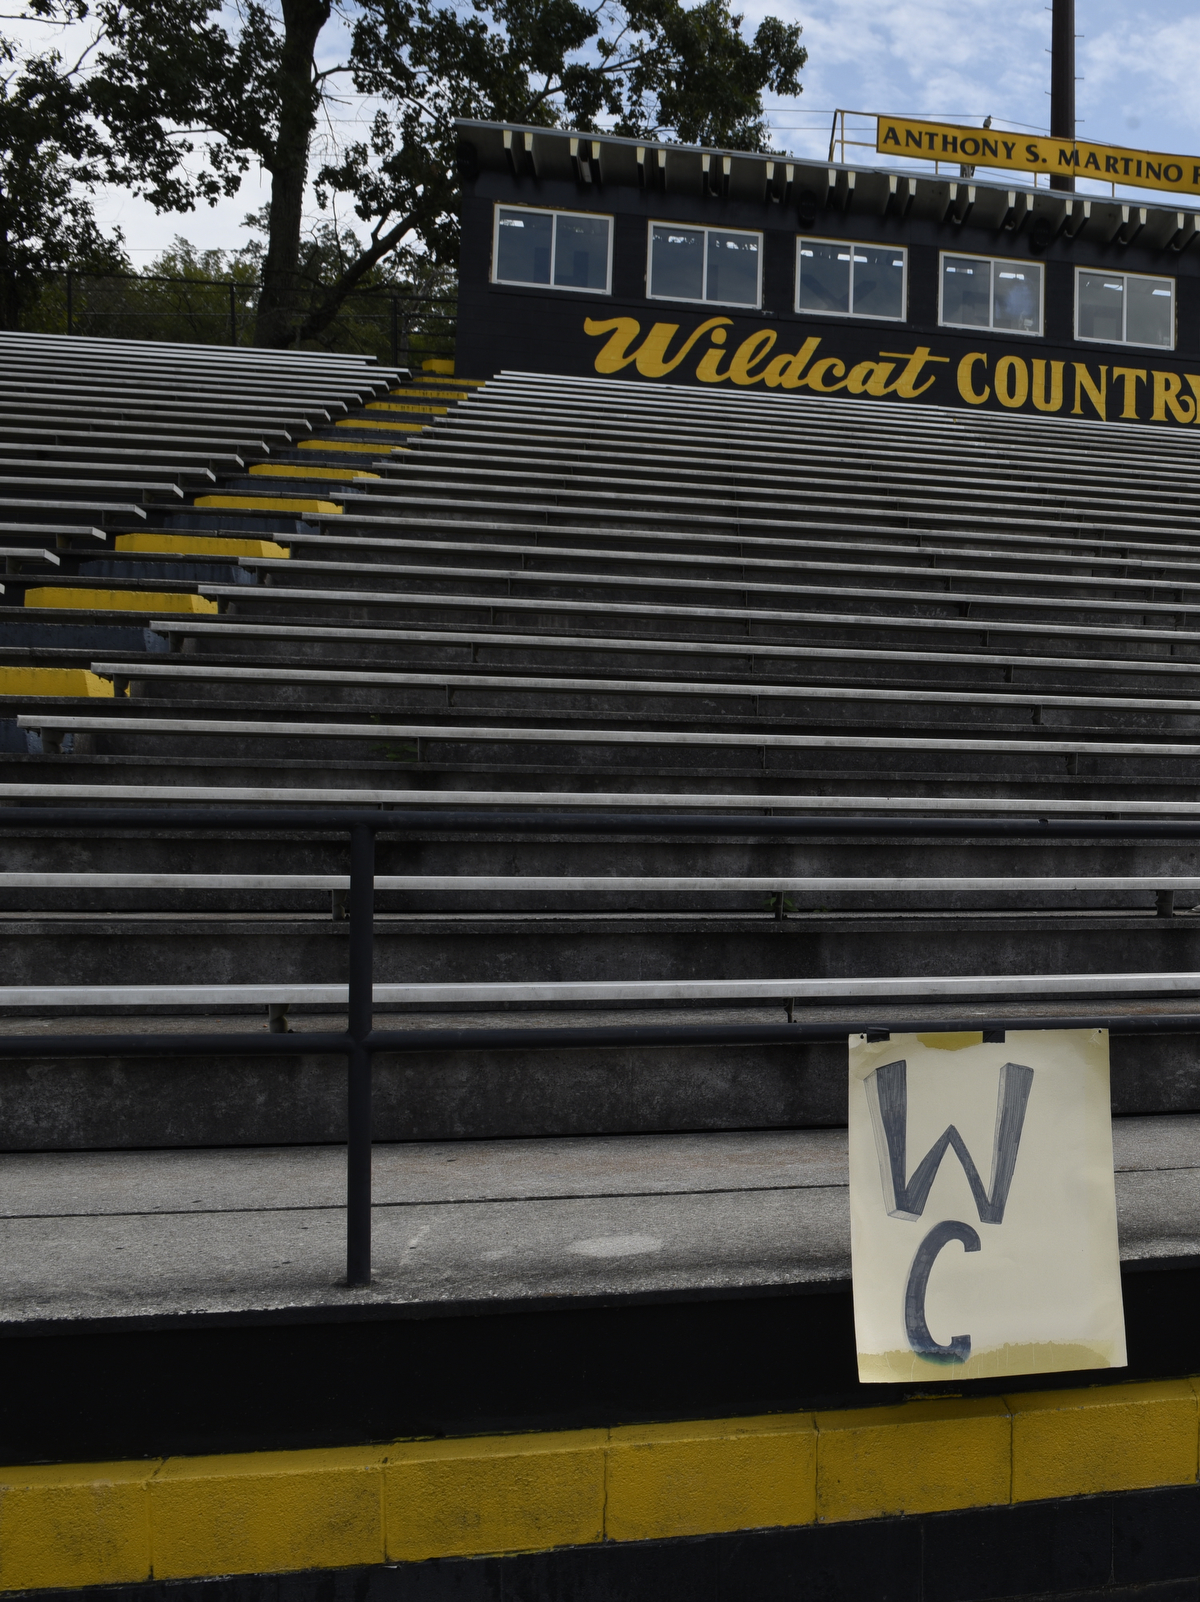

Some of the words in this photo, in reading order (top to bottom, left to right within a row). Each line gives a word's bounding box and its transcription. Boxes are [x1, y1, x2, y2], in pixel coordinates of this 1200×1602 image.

[882, 126, 1017, 160] ANTHONY
[1024, 144, 1048, 164] S.
[1057, 148, 1183, 183] MARTINO
[583, 316, 950, 399] Wildcat
[864, 1059, 1034, 1225] W
